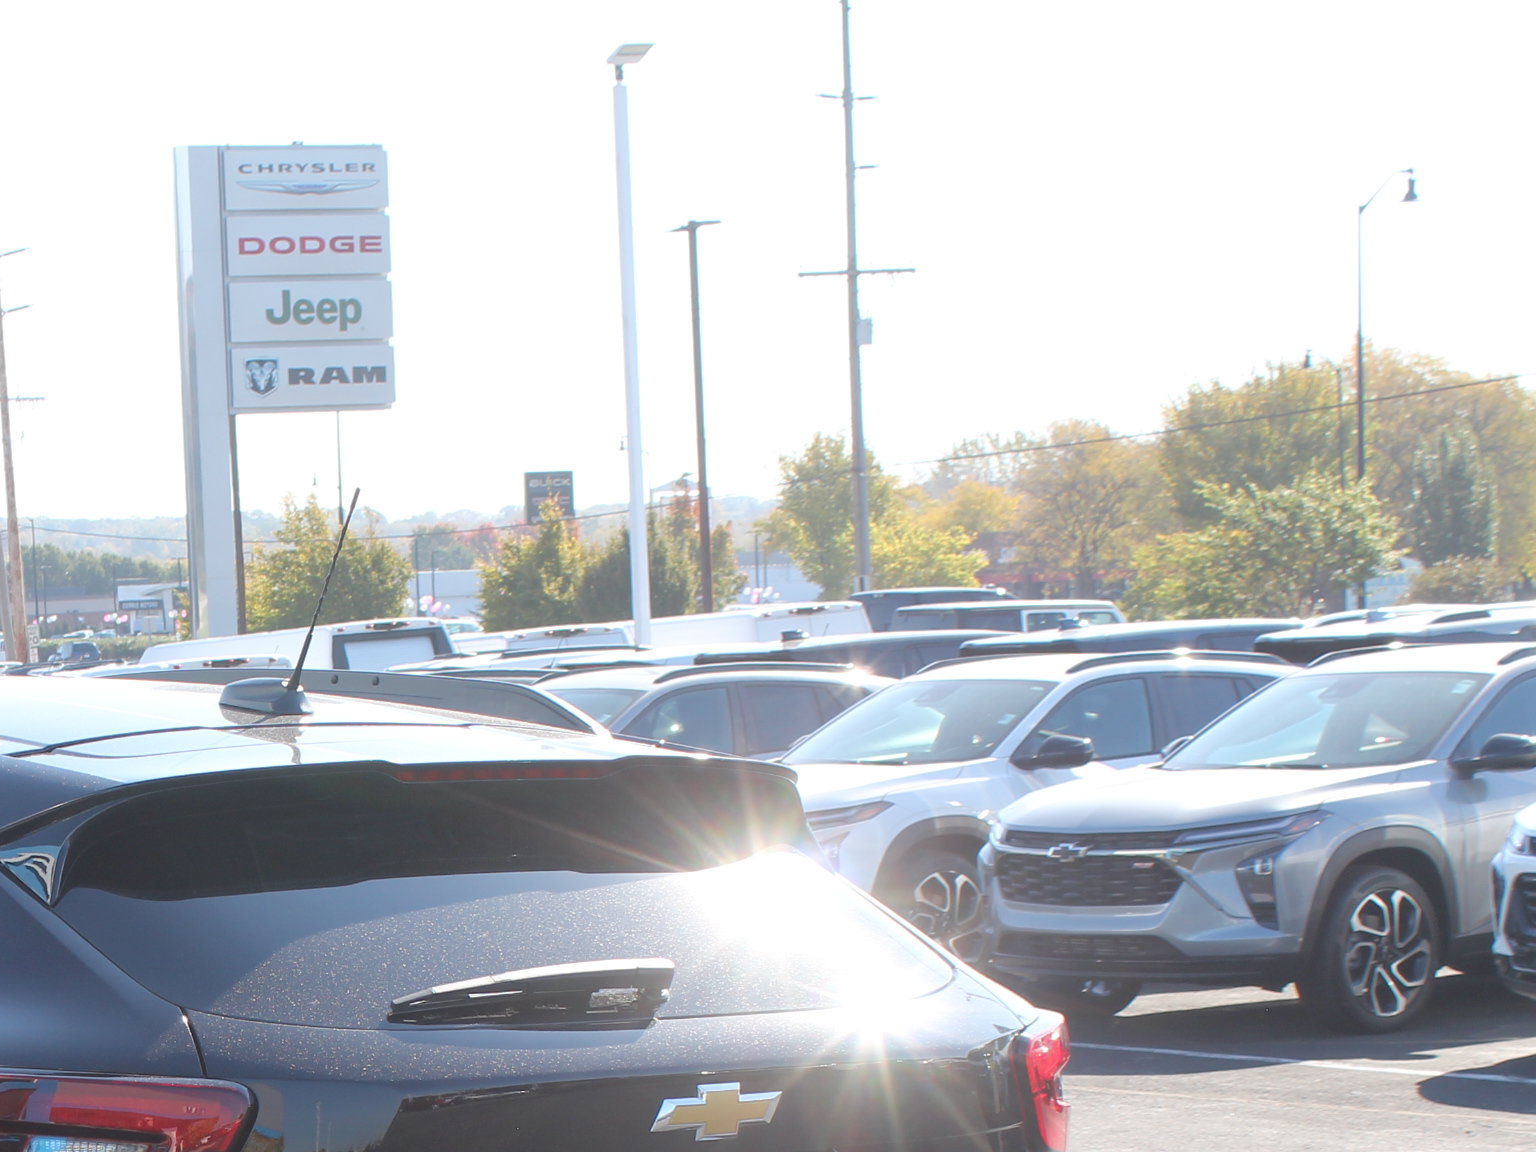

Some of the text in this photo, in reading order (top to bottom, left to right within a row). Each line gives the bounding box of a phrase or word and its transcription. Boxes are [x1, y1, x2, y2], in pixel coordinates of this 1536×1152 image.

[237, 162, 377, 175] CHRYSLER
[237, 235, 384, 256] DODGE
[265, 289, 363, 332] Jeep
[287, 365, 388, 386] RAM
